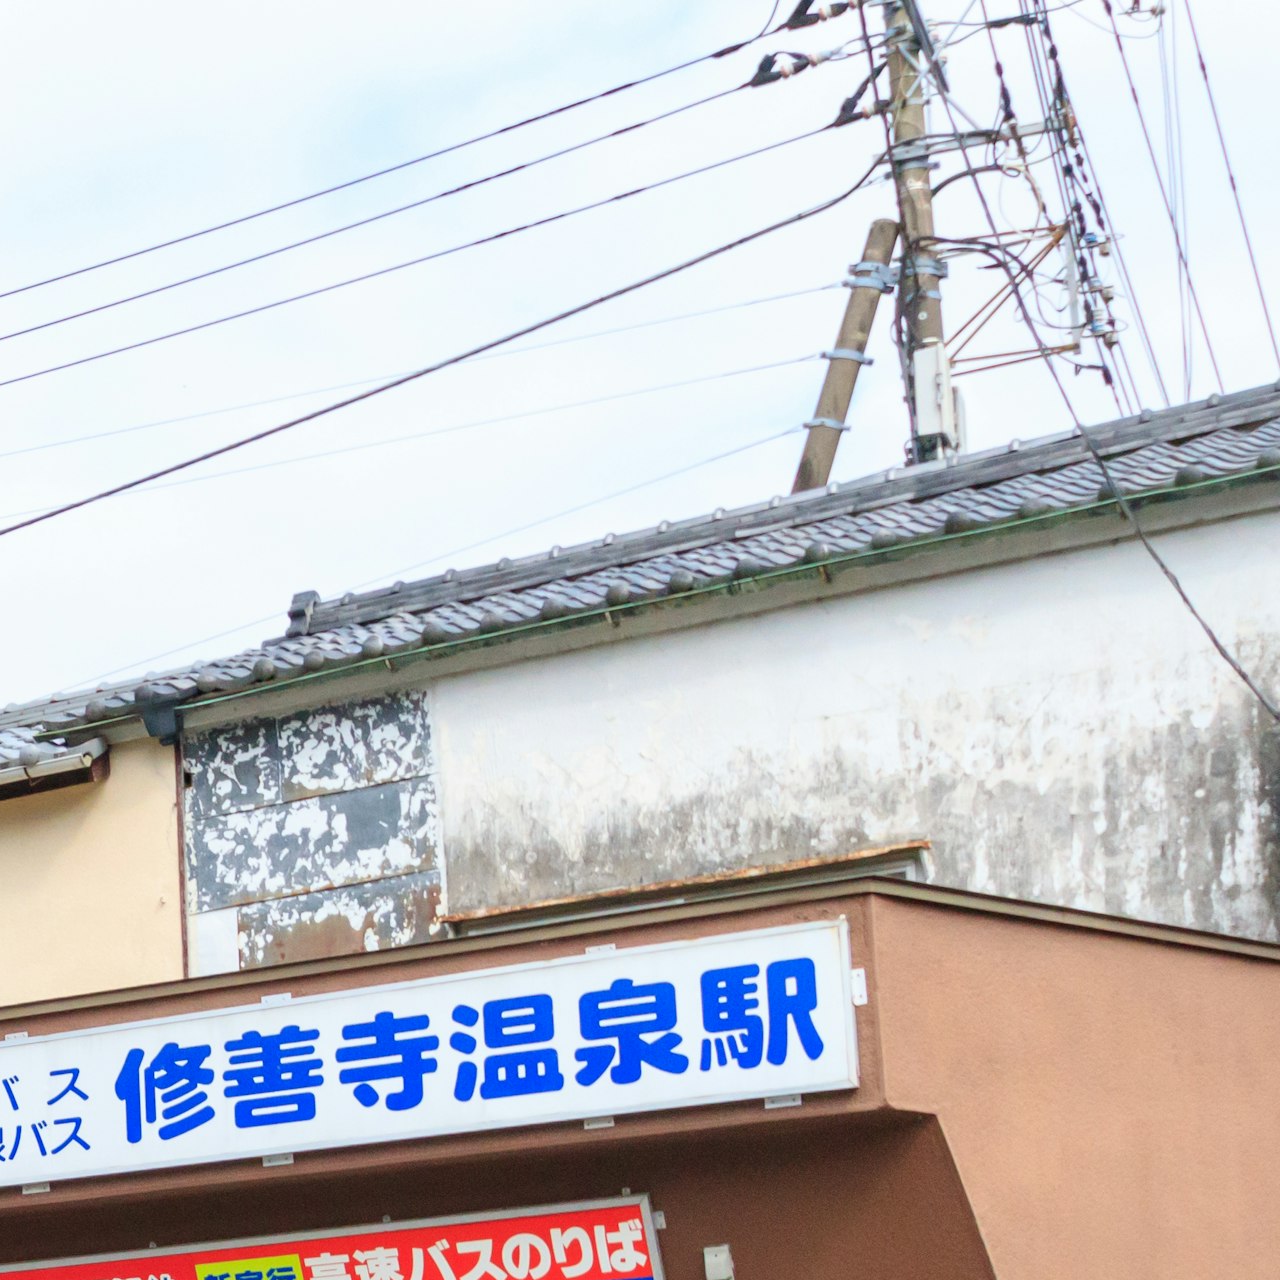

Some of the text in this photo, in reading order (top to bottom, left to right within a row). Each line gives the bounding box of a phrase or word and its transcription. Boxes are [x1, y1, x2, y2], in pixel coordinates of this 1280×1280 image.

[114, 957, 824, 1144] 修善寺温泉駅
